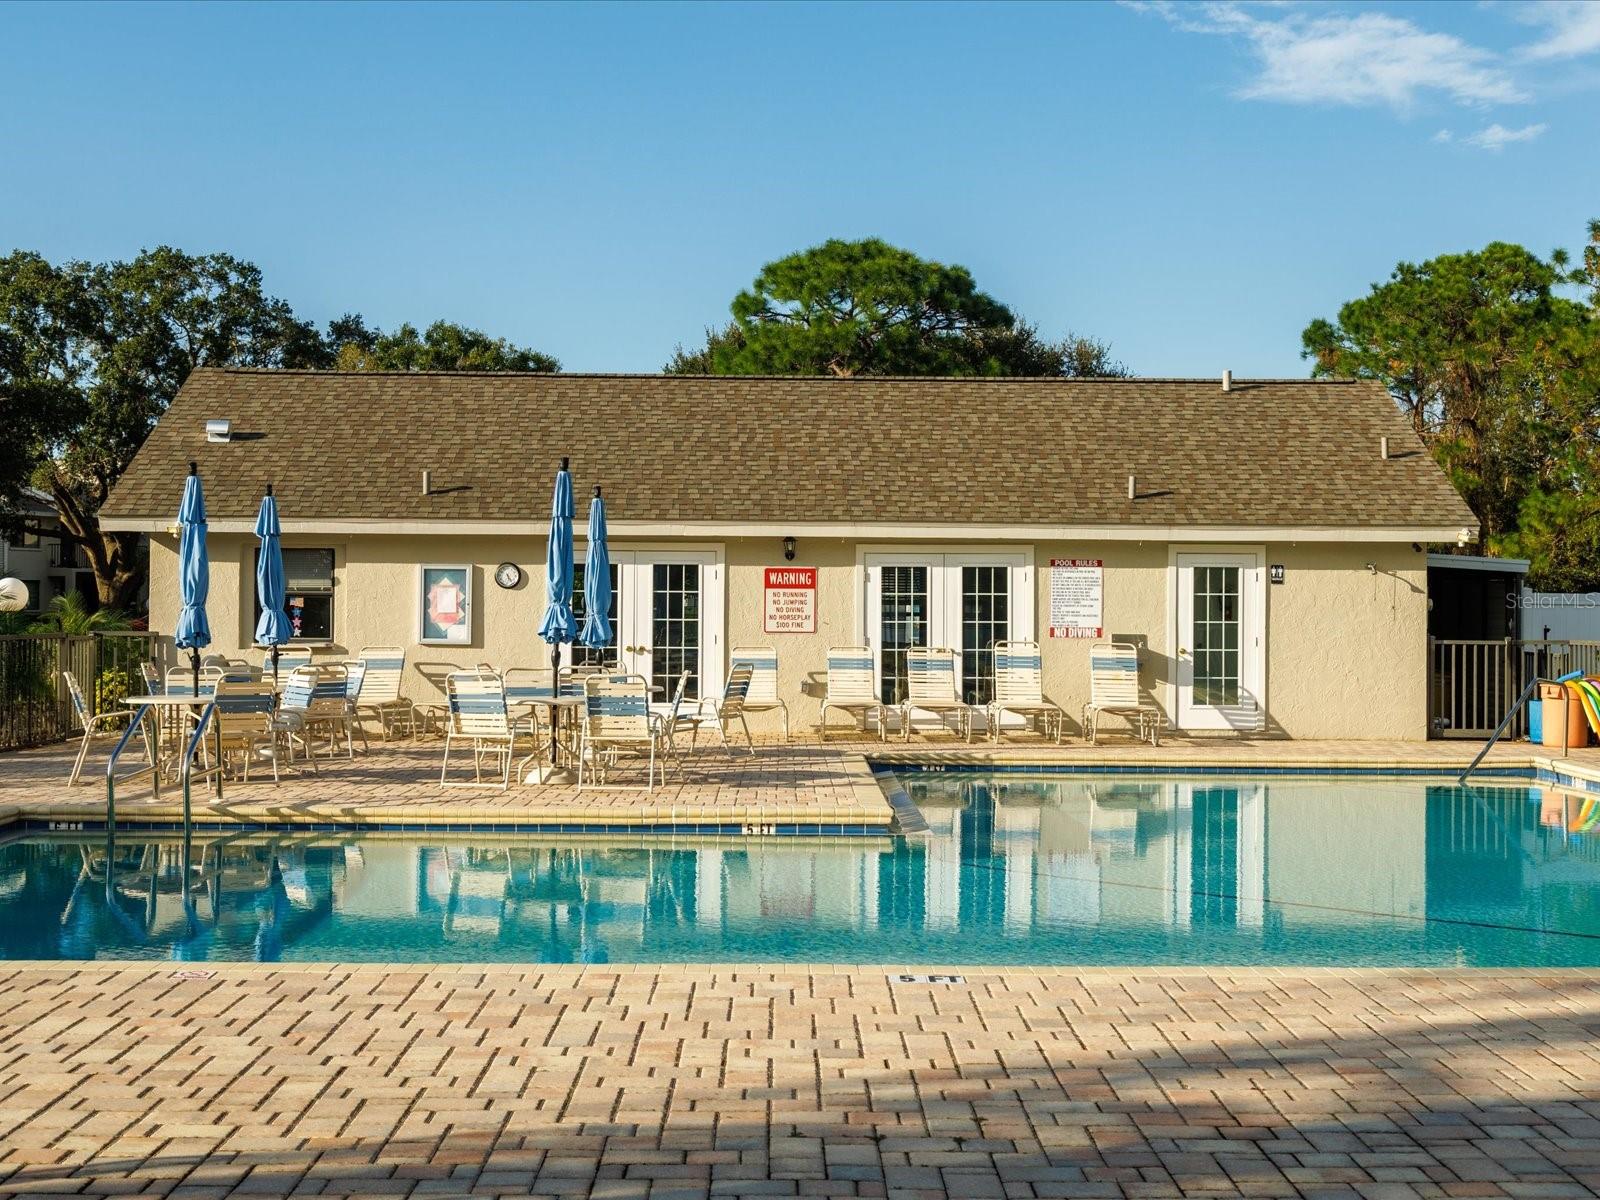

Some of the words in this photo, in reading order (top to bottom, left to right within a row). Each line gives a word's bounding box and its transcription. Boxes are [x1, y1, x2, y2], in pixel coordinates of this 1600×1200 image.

[769, 572, 812, 585] WARNING
[1055, 628, 1067, 638] NO
[1069, 628, 1097, 638] DIVING
[747, 823, 754, 834] 5
[760, 823, 773, 834] FT
[899, 975, 917, 983] 5
